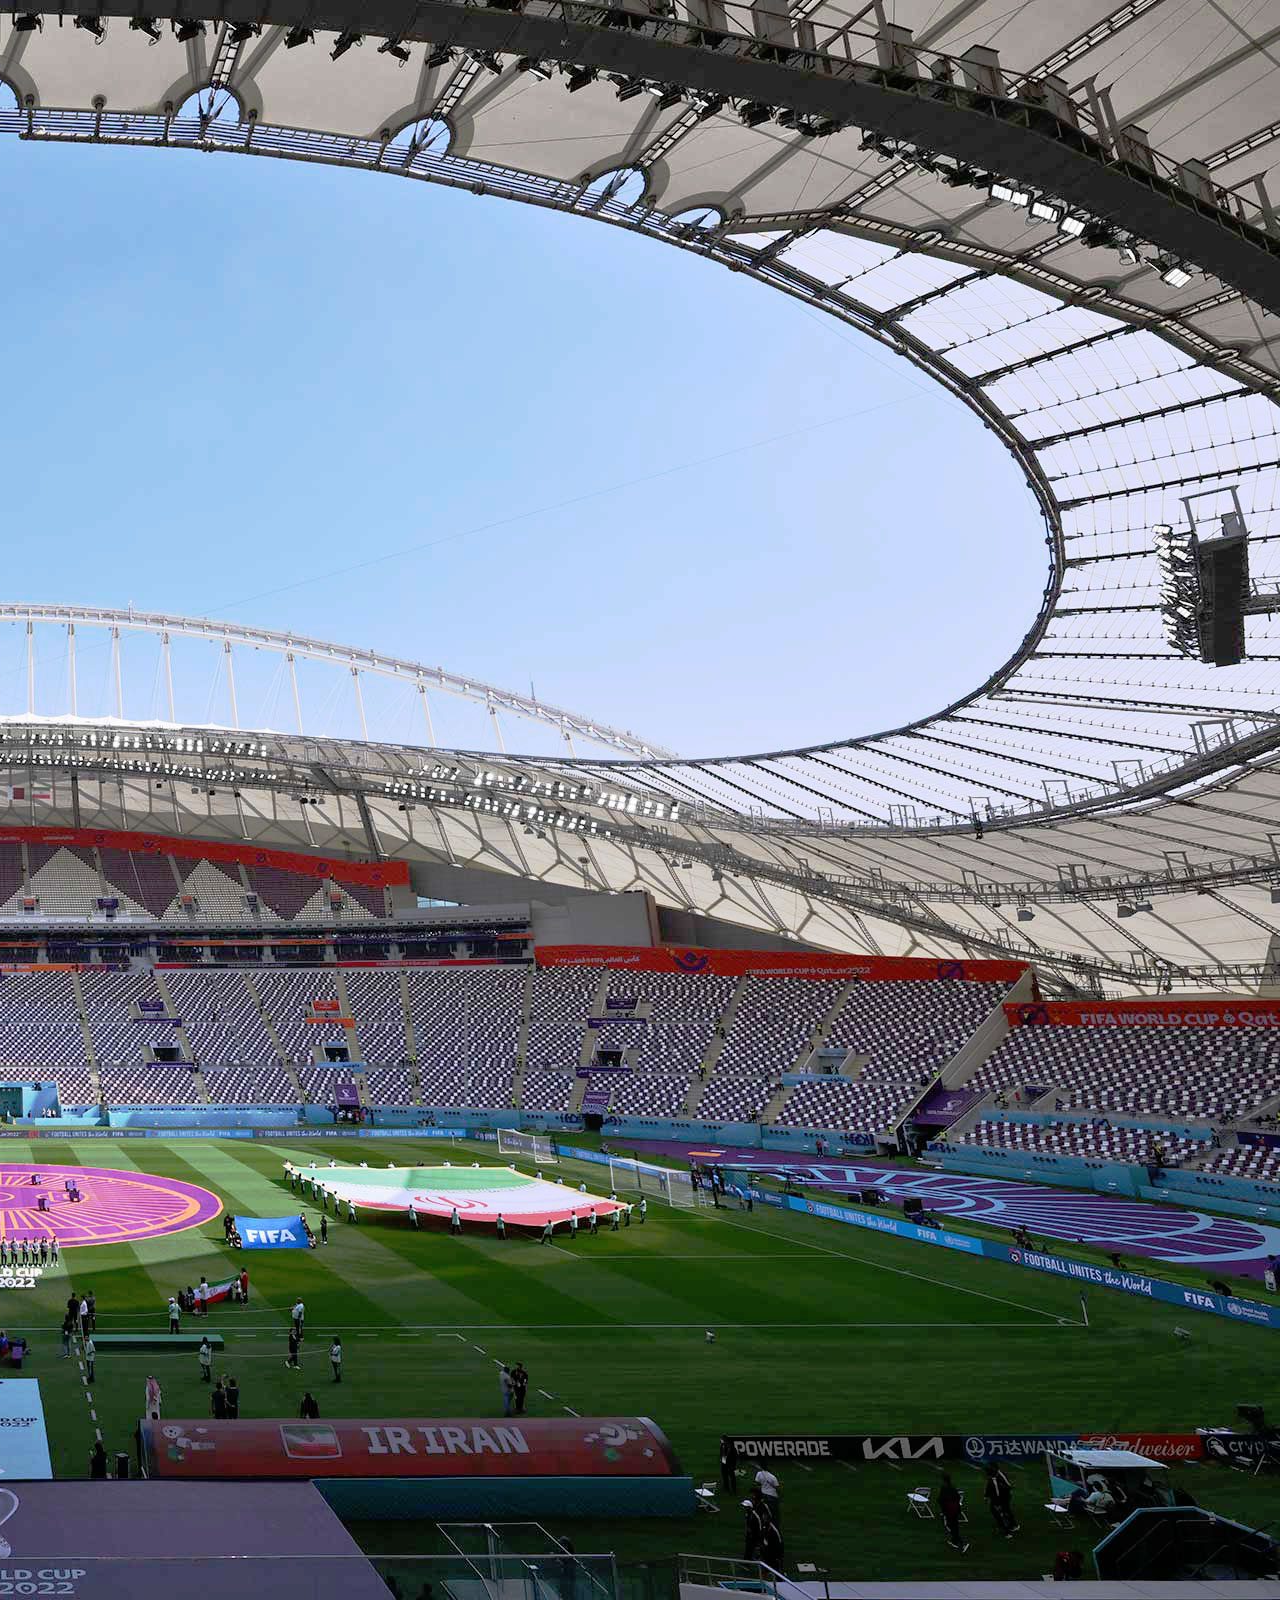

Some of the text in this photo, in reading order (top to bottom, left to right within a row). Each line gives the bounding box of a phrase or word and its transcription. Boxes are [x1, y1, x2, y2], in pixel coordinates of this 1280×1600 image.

[1080, 1013, 1117, 1025] FIFA
[1117, 1013, 1182, 1025] WORLD
[1183, 1013, 1220, 1024] CUP
[815, 1204, 843, 1220] FOOTBALL
[844, 1211, 866, 1225] UNITES
[917, 1229, 938, 1241] FIFA
[245, 1229, 297, 1244] FIFA
[15, 1267, 43, 1278] CUP
[1023, 1252, 1216, 1309] FOOTBALL UNITES the World FIFA
[361, 1426, 530, 1454] IR IRAN
[733, 1440, 832, 1457] POWERADE
[36, 1569, 88, 1581] CUP
